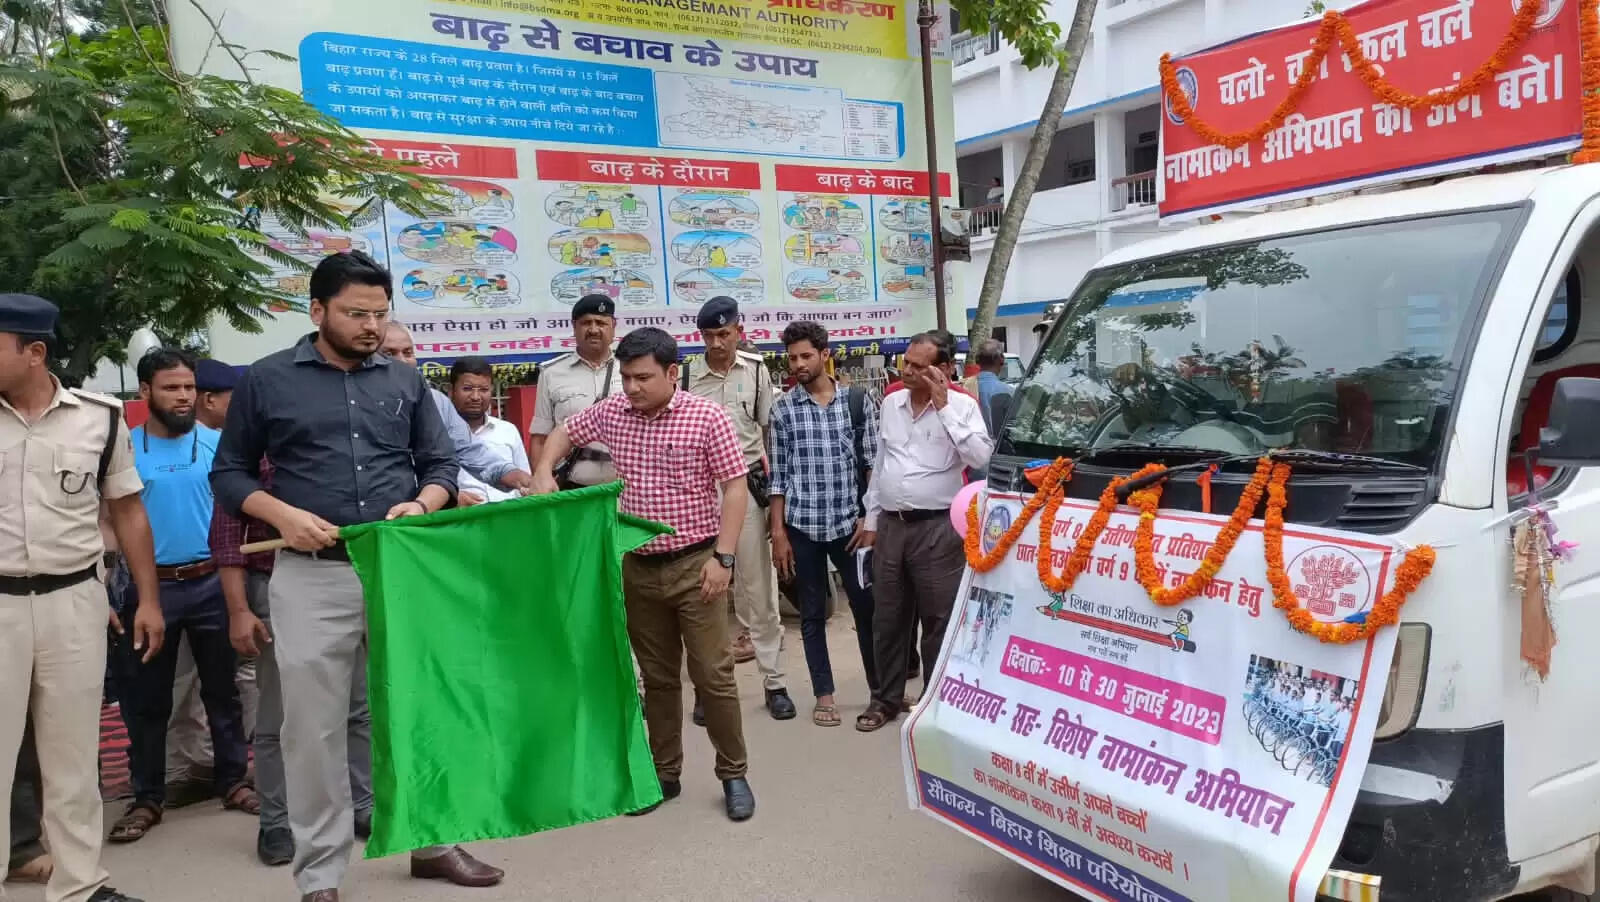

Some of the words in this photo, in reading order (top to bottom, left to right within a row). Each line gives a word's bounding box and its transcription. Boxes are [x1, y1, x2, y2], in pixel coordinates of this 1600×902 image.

[756, 10, 849, 31] AUTHORITY
[322, 40, 356, 57] बिहार
[362, 47, 391, 59] राज्य
[392, 49, 408, 61] के
[413, 53, 427, 63] 28
[582, 71, 593, 81] 15
[430, 13, 511, 50] बाढ़
[520, 18, 562, 51] से
[572, 31, 674, 63] बचाव
[683, 39, 723, 67] के
[732, 50, 819, 79] उपाय
[328, 81, 341, 94] के
[384, 86, 402, 99] को
[407, 92, 458, 104] अपनाकर
[1217, 57, 1275, 105] चलो-
[392, 145, 460, 169] पहले
[1261, 113, 1364, 164] अभियान
[588, 159, 635, 181] बाढ़
[638, 157, 664, 179] के
[670, 159, 730, 183] दौरान
[816, 172, 853, 191] बाढ़
[856, 169, 877, 188] के
[880, 175, 914, 192] बाद
[441, 319, 480, 331] ऐसा
[515, 317, 537, 330] जो
[752, 312, 770, 322] जो
[776, 311, 794, 322] कि
[799, 311, 837, 321] आफत
[842, 311, 861, 321] बन
[1052, 516, 1074, 538] वर्ग
[1097, 554, 1117, 579] वर्ग
[1120, 561, 1129, 581] 9
[1238, 577, 1264, 617] हेतु
[1070, 593, 1094, 614] शिक्षा
[1097, 602, 1112, 618] का
[1114, 604, 1160, 629] अधिकार
[1093, 630, 1110, 646] शिक्षा
[1111, 636, 1138, 653] अभियान
[1057, 664, 1075, 686] 10
[1079, 664, 1094, 692] से
[1095, 676, 1118, 699] 30
[1122, 683, 1170, 719] जुलाई
[1170, 699, 1221, 734] 2023
[1044, 707, 1098, 760] विशेष
[1097, 734, 1188, 795] नामांकन
[1185, 767, 1295, 836] अभियान
[973, 767, 986, 785] का
[1030, 794, 1056, 819] कक्षा
[1081, 813, 1093, 837] में
[1096, 825, 1134, 856] अवश्य
[990, 751, 1013, 775] कक्षा
[1037, 767, 1049, 789] में
[1083, 791, 1114, 819] अपने
[1116, 805, 1148, 834] बच्चों
[990, 806, 1033, 845] बिहार
[1037, 829, 1083, 870] शिक्षा
